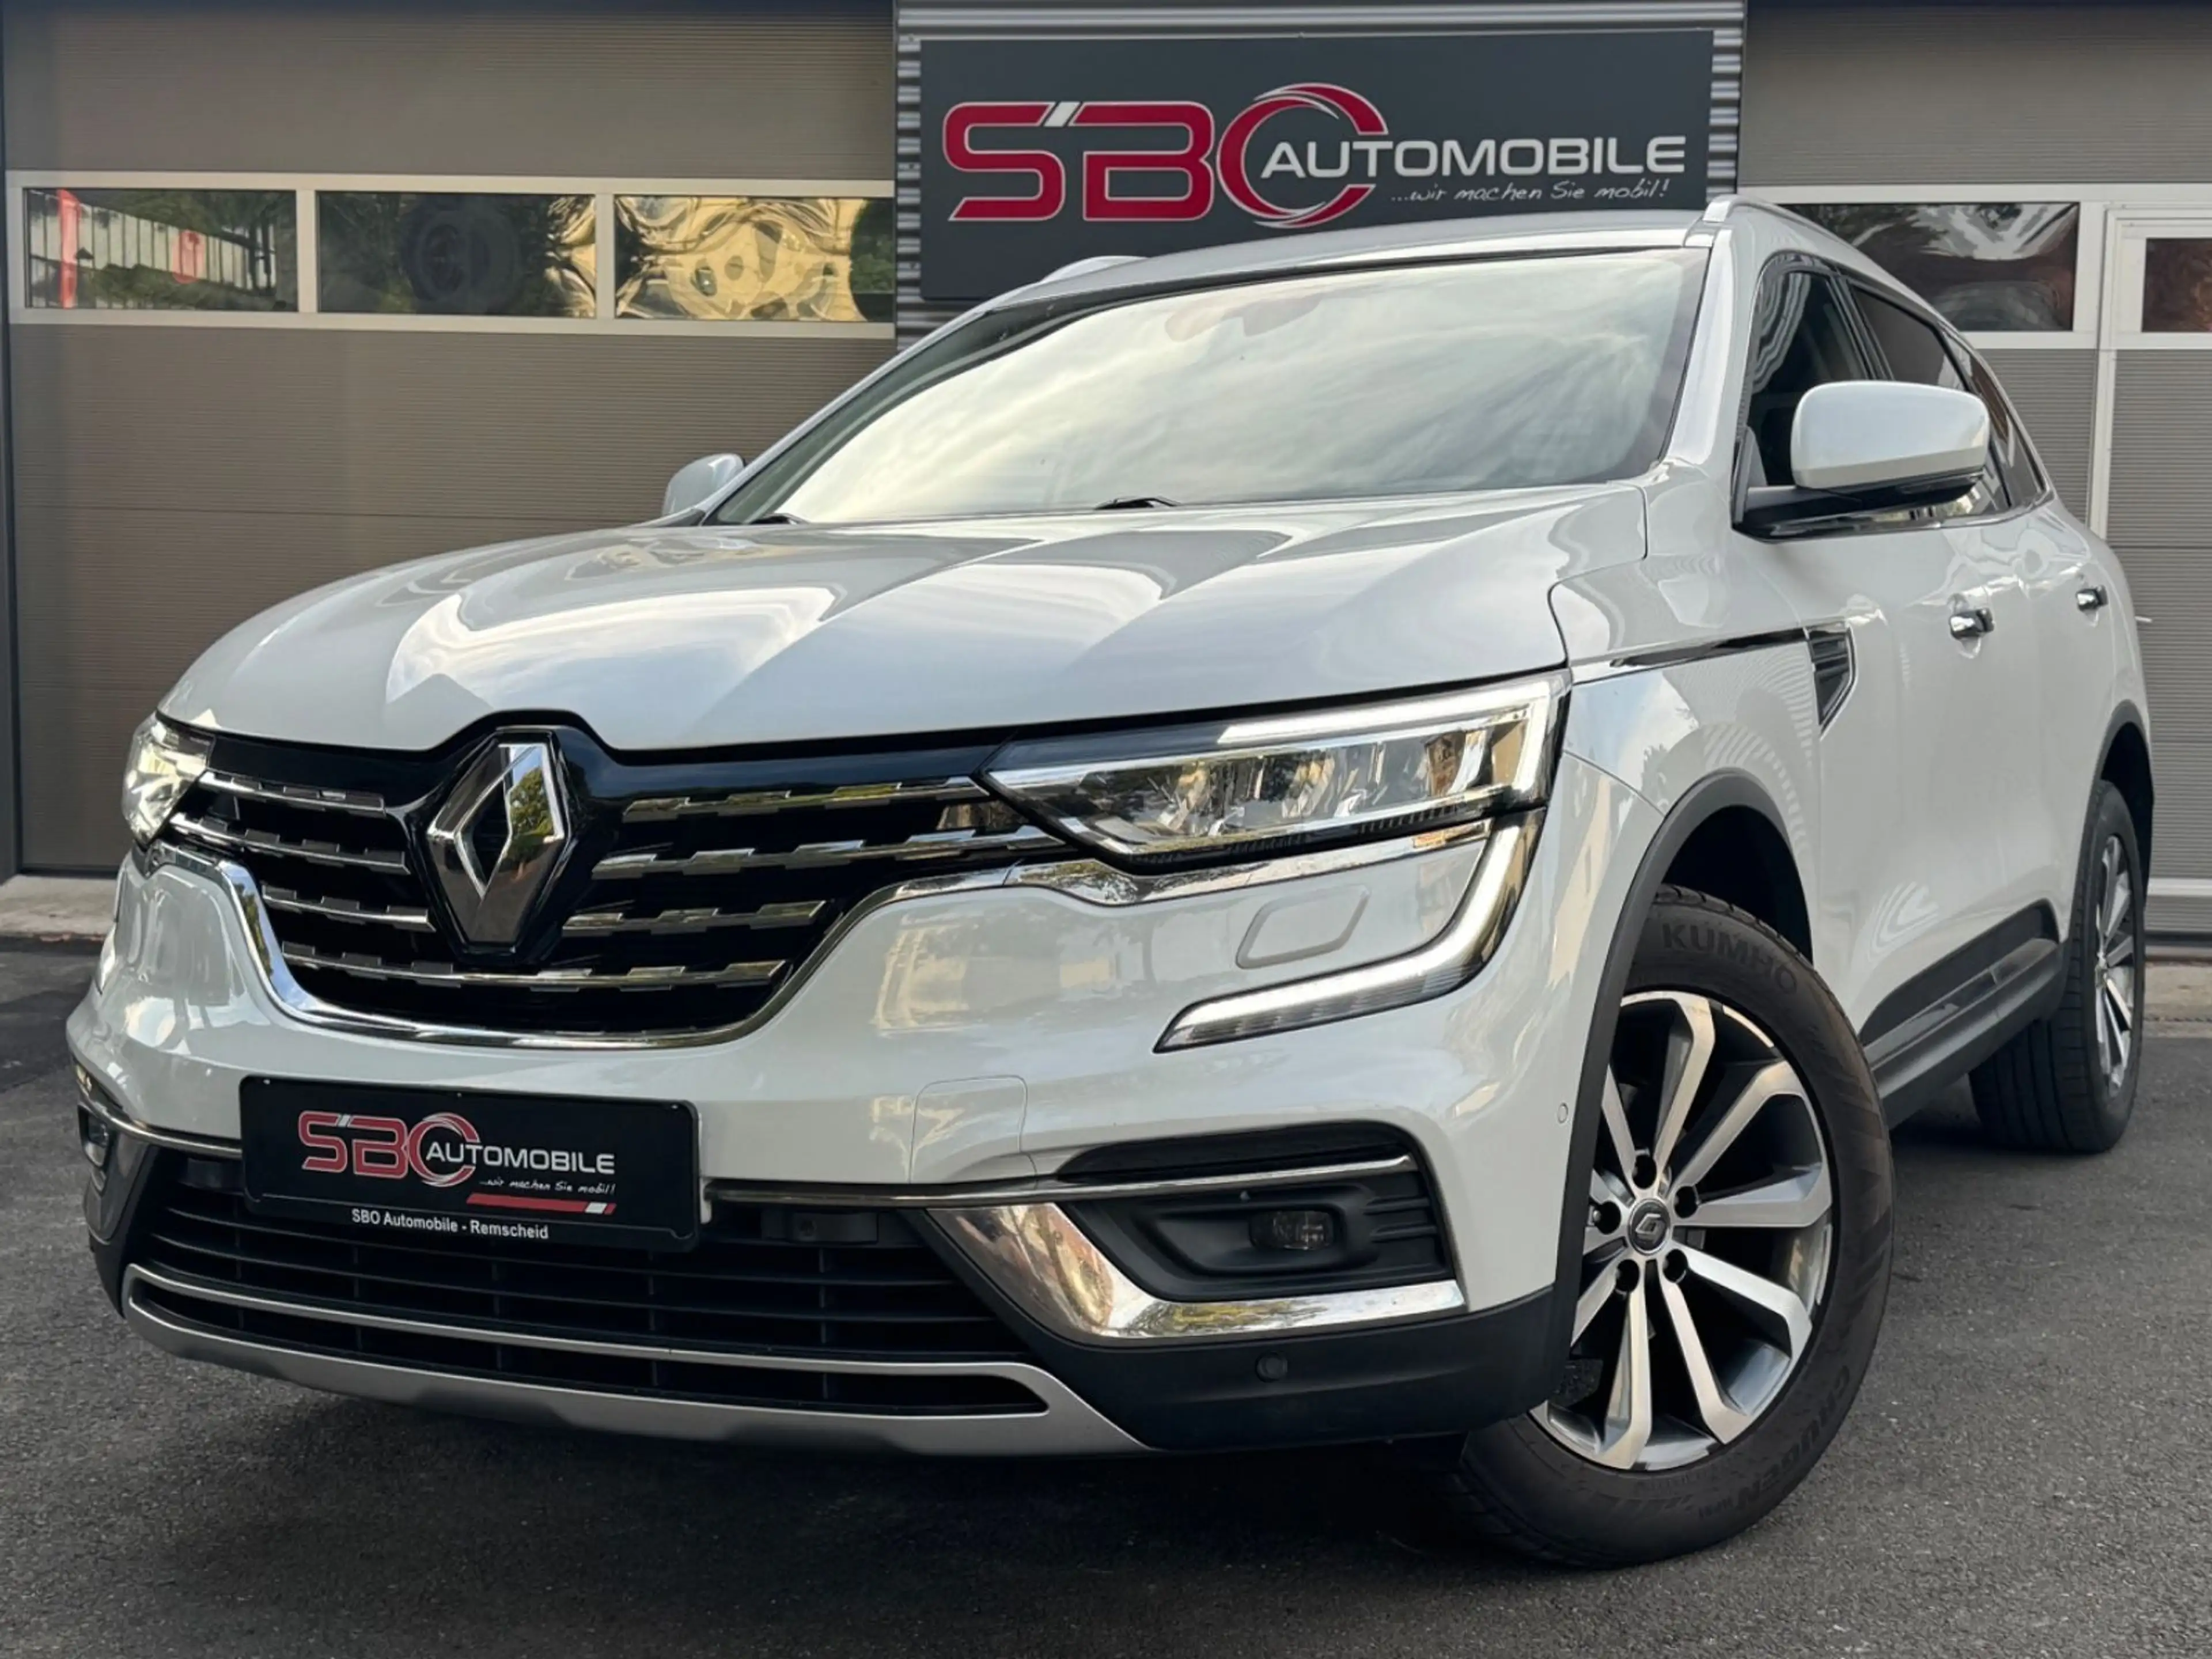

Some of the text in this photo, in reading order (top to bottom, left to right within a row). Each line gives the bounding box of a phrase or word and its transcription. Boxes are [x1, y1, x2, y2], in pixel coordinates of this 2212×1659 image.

[1260, 135, 1687, 179] AUTOMOBILE
[1453, 181, 1543, 201] machen
[1550, 179, 1585, 200] Sie
[1593, 177, 1671, 199] mobil!
[1662, 922, 1797, 995] KUMHO
[425, 1141, 615, 1175] AUTOMOBILE
[509, 1179, 551, 1191] machen
[554, 1181, 573, 1192] Sie
[351, 1208, 381, 1225] SBO
[383, 1211, 459, 1233] Automobile
[469, 1219, 549, 1239] Remscheid
